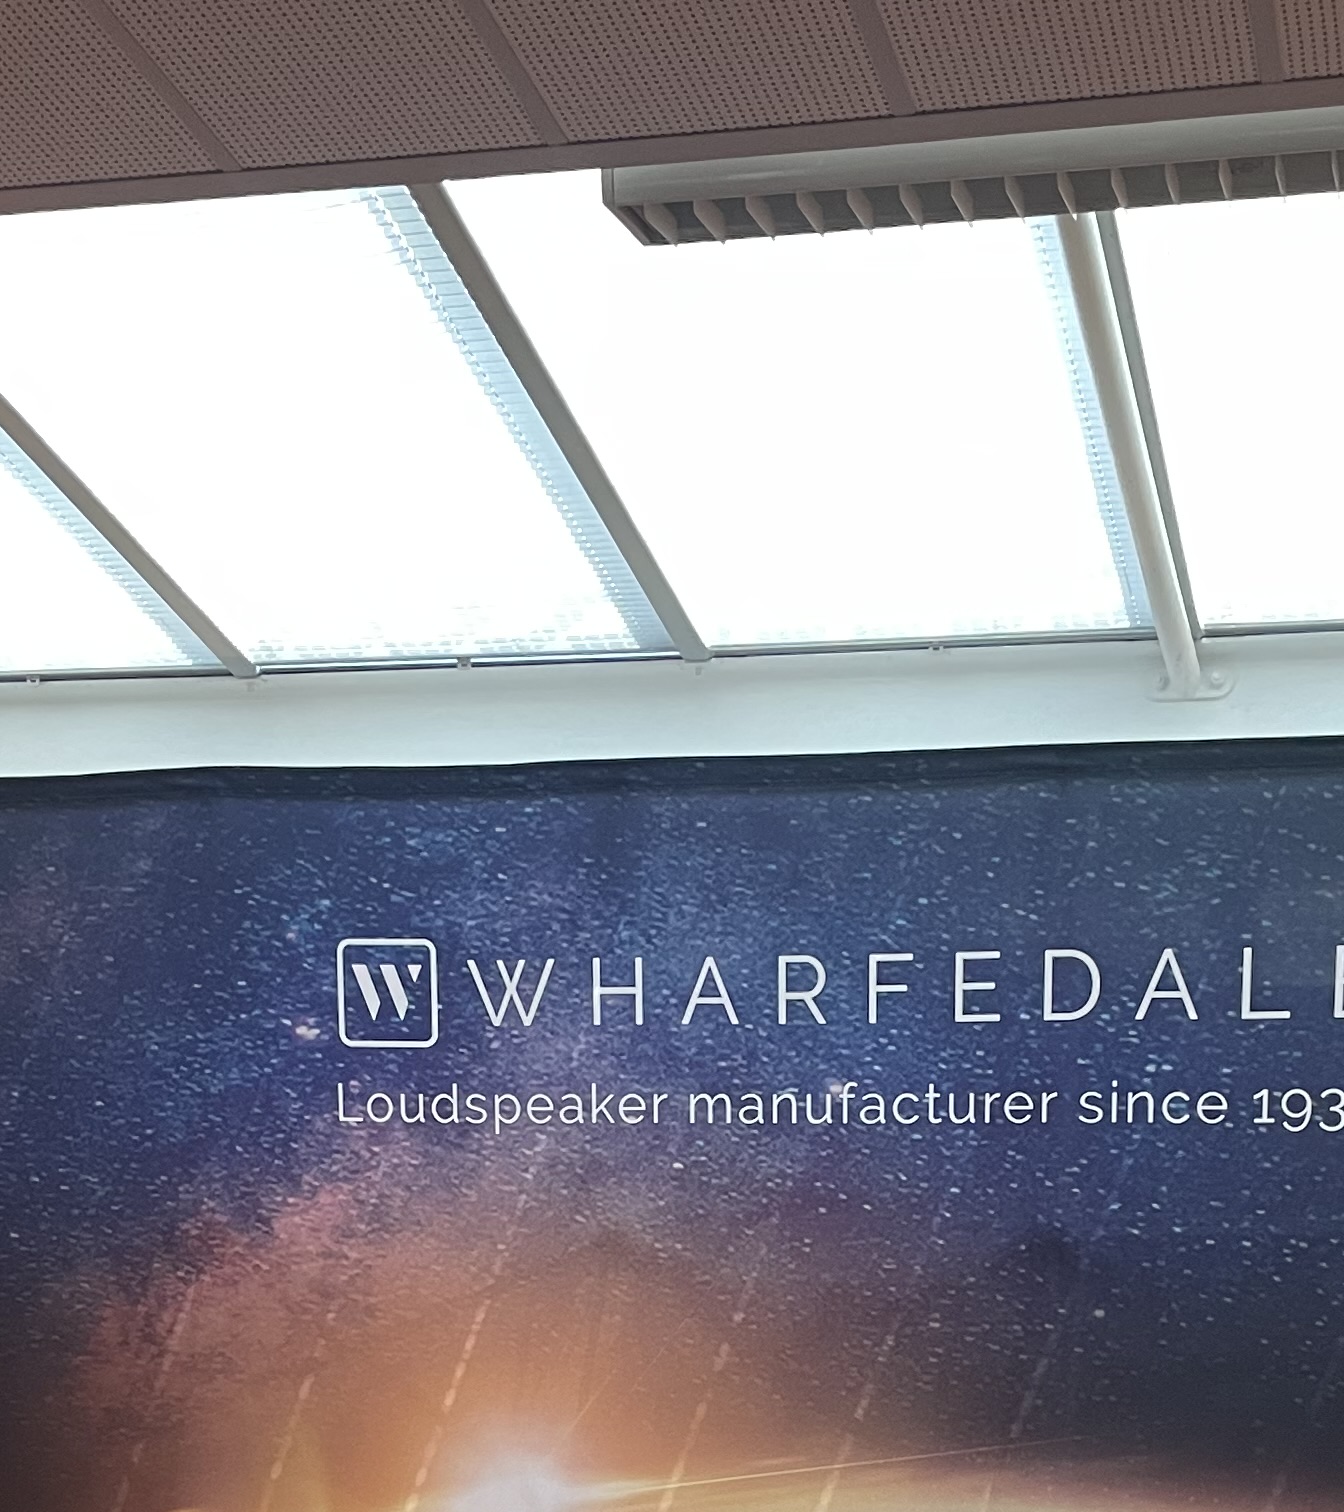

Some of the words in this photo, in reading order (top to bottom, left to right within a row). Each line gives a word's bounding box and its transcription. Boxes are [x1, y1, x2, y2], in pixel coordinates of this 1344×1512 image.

[337, 1082, 669, 1135] Loudspeaker
[689, 1081, 1058, 1125] manufacturer
[1078, 1081, 1228, 1124] since
